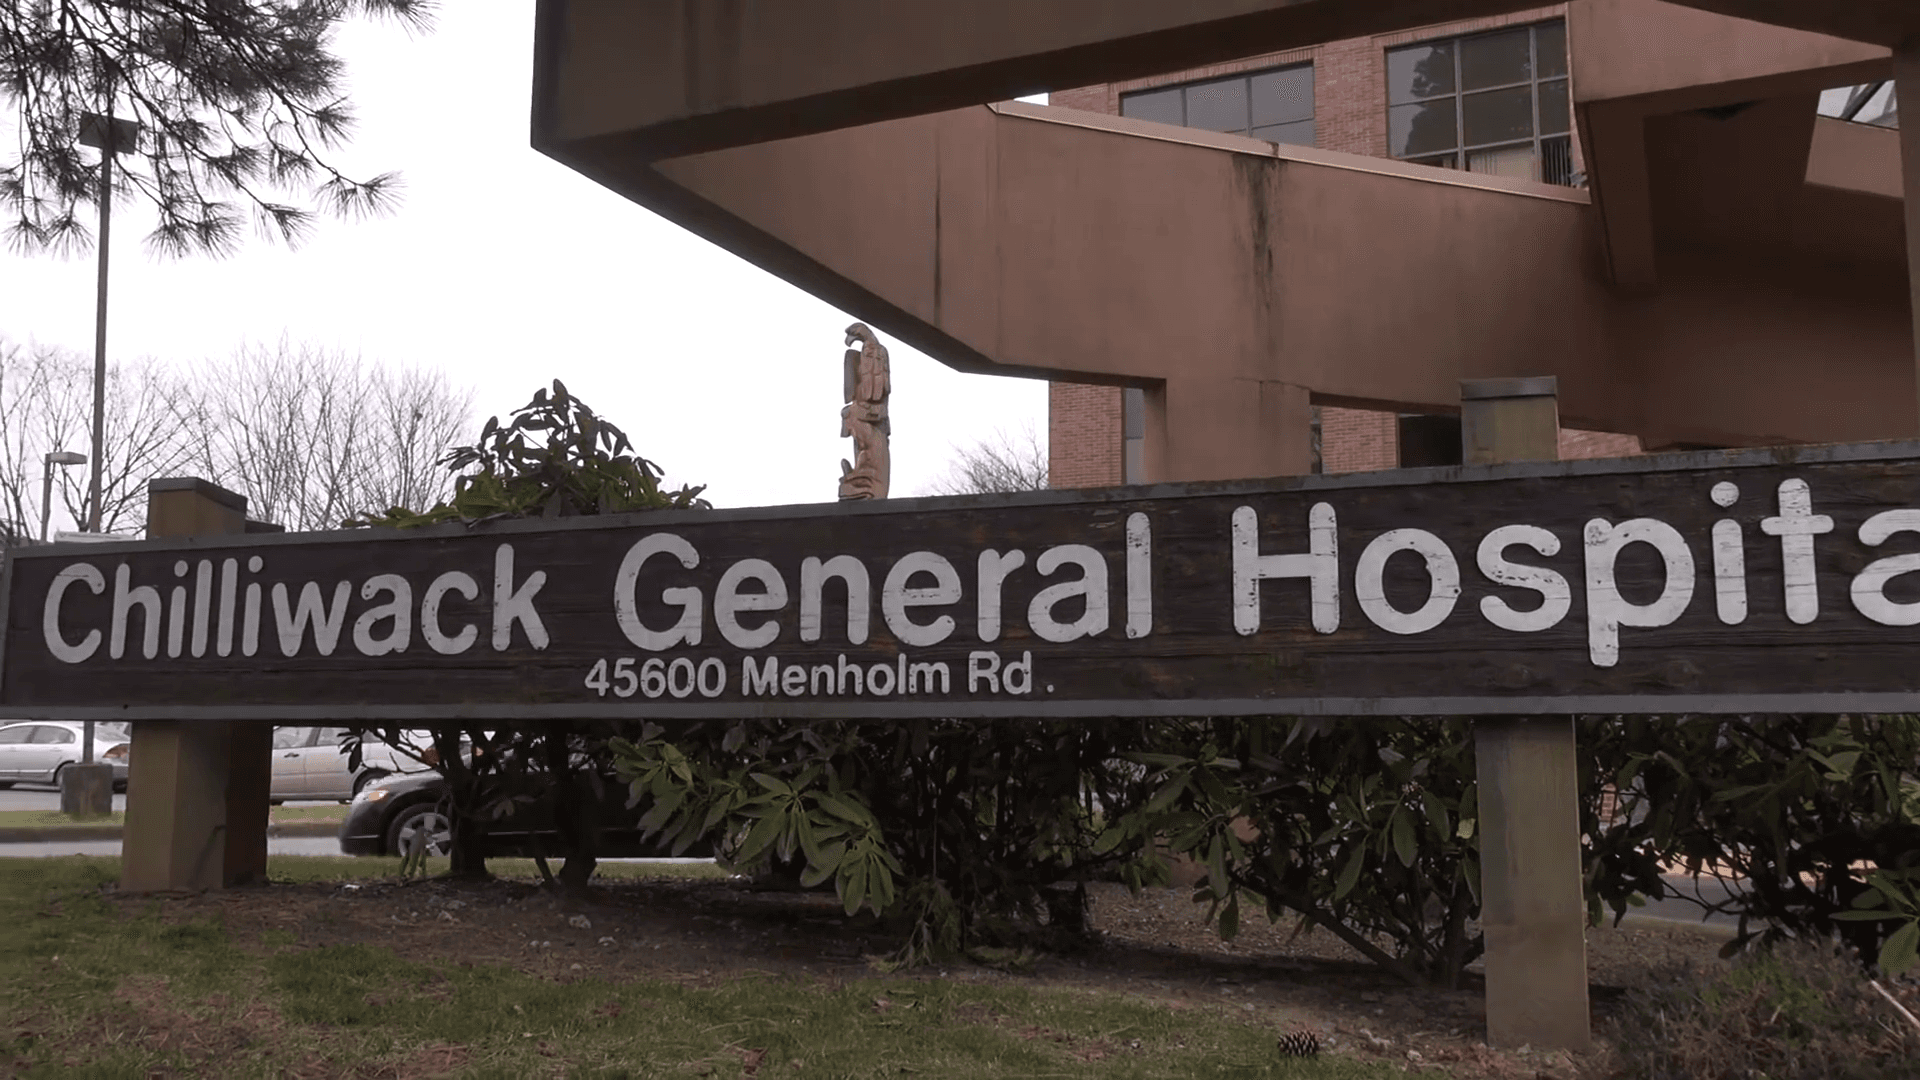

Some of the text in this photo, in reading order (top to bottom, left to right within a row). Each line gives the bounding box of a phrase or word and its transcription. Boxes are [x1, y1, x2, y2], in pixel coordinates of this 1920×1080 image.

[42, 543, 551, 664] Chilliwack
[613, 511, 1154, 652] General
[583, 649, 1056, 699] 45600 Menholm Rd.
